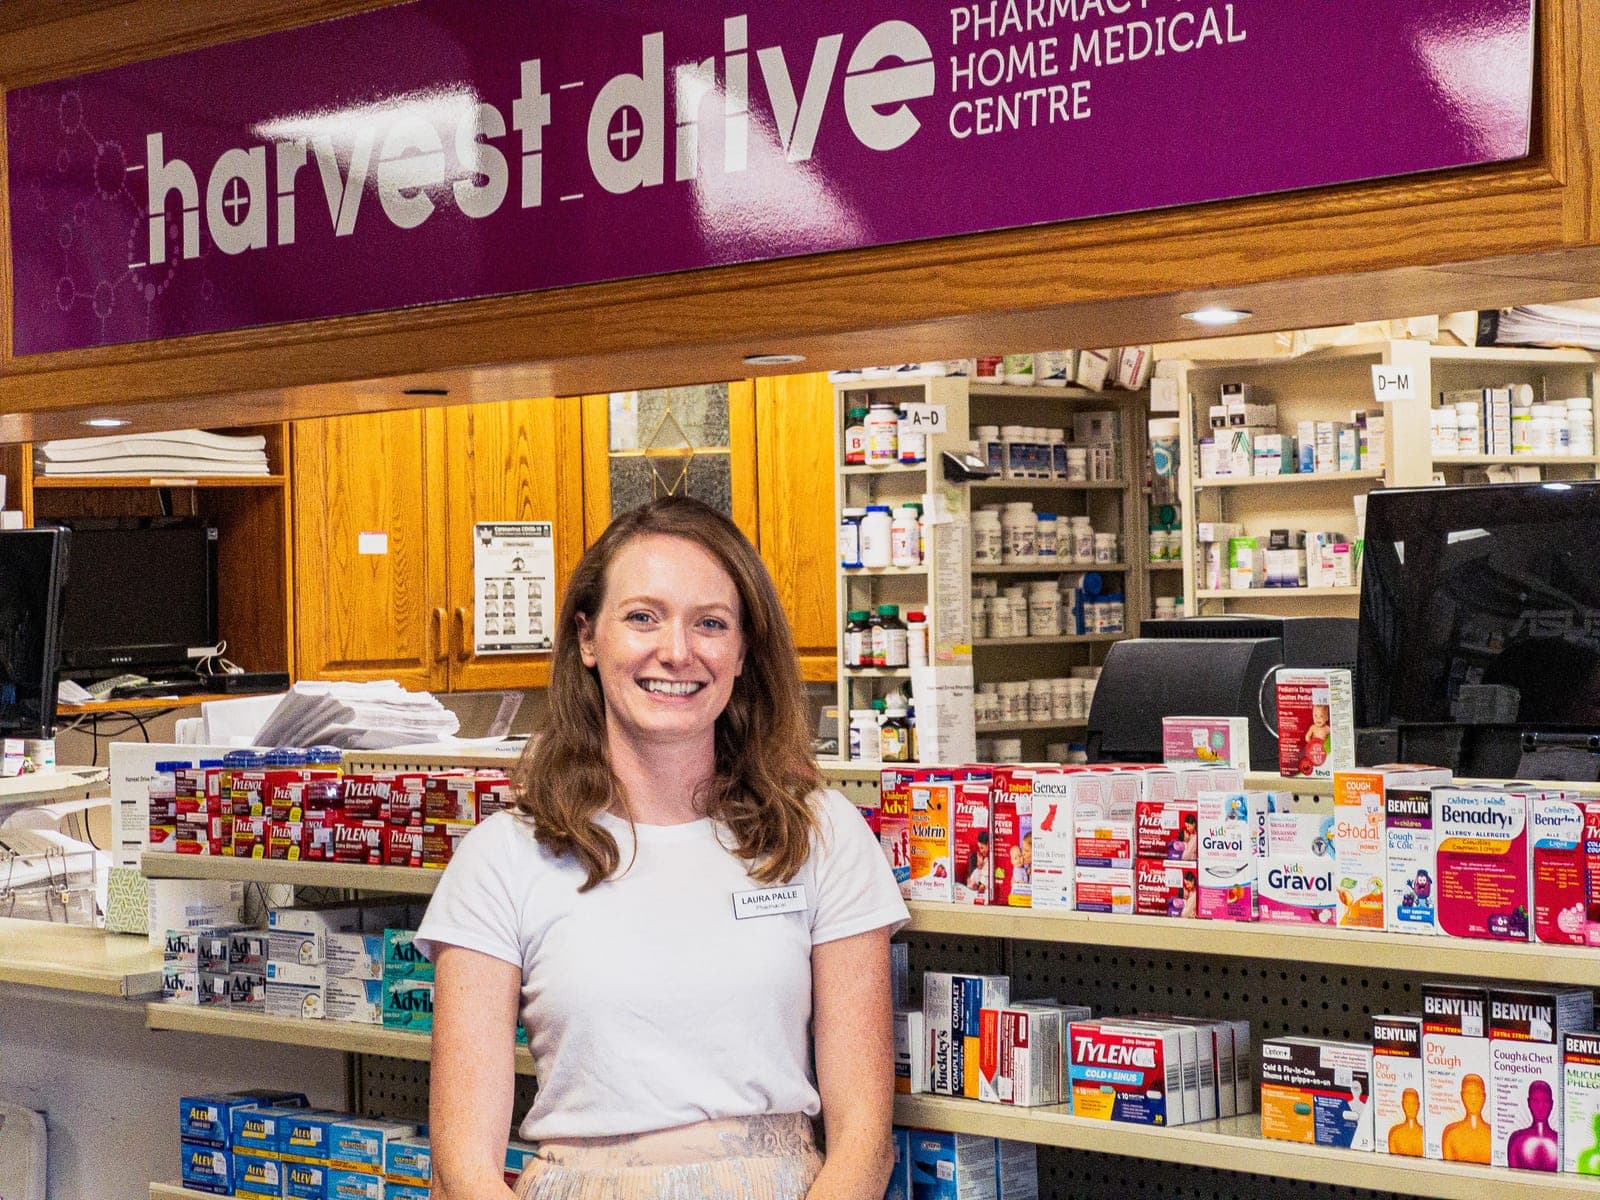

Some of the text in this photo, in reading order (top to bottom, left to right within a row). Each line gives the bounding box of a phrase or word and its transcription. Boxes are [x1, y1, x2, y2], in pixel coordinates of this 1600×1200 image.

[950, 0, 1147, 45] PHARMA
[950, 4, 1246, 92] HOME MEDICAL
[949, 80, 1091, 139] CENTRE
[147, 14, 935, 265] harvest drive
[1378, 374, 1409, 391] D-M
[913, 410, 939, 425] A-D
[273, 786, 292, 799] TYLE
[1033, 781, 1067, 794] Genexa
[1346, 781, 1371, 791] COUGH
[391, 790, 410, 803] TYLE
[882, 801, 908, 814] Advi
[956, 803, 975, 814] TYLE
[1388, 799, 1429, 814] BENYLIN
[235, 819, 253, 832] TYLE
[1139, 814, 1162, 826] TYLE
[272, 825, 291, 838] TYLEN
[391, 830, 414, 843] TYLEN
[912, 824, 946, 838] Motrin
[1337, 822, 1379, 840] Stodal
[1388, 832, 1412, 842] Cough
[1202, 837, 1242, 851] Gravol
[1283, 862, 1303, 874] kids
[1268, 869, 1332, 891] Gravol
[742, 890, 798, 905] LAURA PALLE
[392, 942, 431, 963] Adv
[163, 974, 193, 991] Adv
[1424, 996, 1484, 1017] BENYLIN
[1492, 1001, 1552, 1023] BENYLIN
[1374, 1026, 1417, 1042] BENYLIN
[1075, 1036, 1156, 1068] TYLENO
[1426, 1042, 1445, 1056] Dry
[1566, 1038, 1600, 1054] BENYL
[936, 1030, 950, 1091] Buckley's
[1426, 1054, 1461, 1069] Cough
[1494, 1049, 1521, 1064] Cough
[1528, 1052, 1553, 1064] Chest
[952, 1040, 960, 1091] COMPLETE
[1263, 1063, 1277, 1071] Cold
[1494, 1060, 1542, 1074] Congestion
[1085, 1069, 1107, 1078] COLD
[1113, 1071, 1137, 1082] SINUS
[1375, 1070, 1397, 1082] Coug
[1567, 1080, 1600, 1090] PHLEG
[189, 1106, 208, 1121] ALEV
[293, 1127, 312, 1139] ALEV
[247, 1164, 265, 1177] ALEV
[291, 1169, 312, 1185] ALEV
